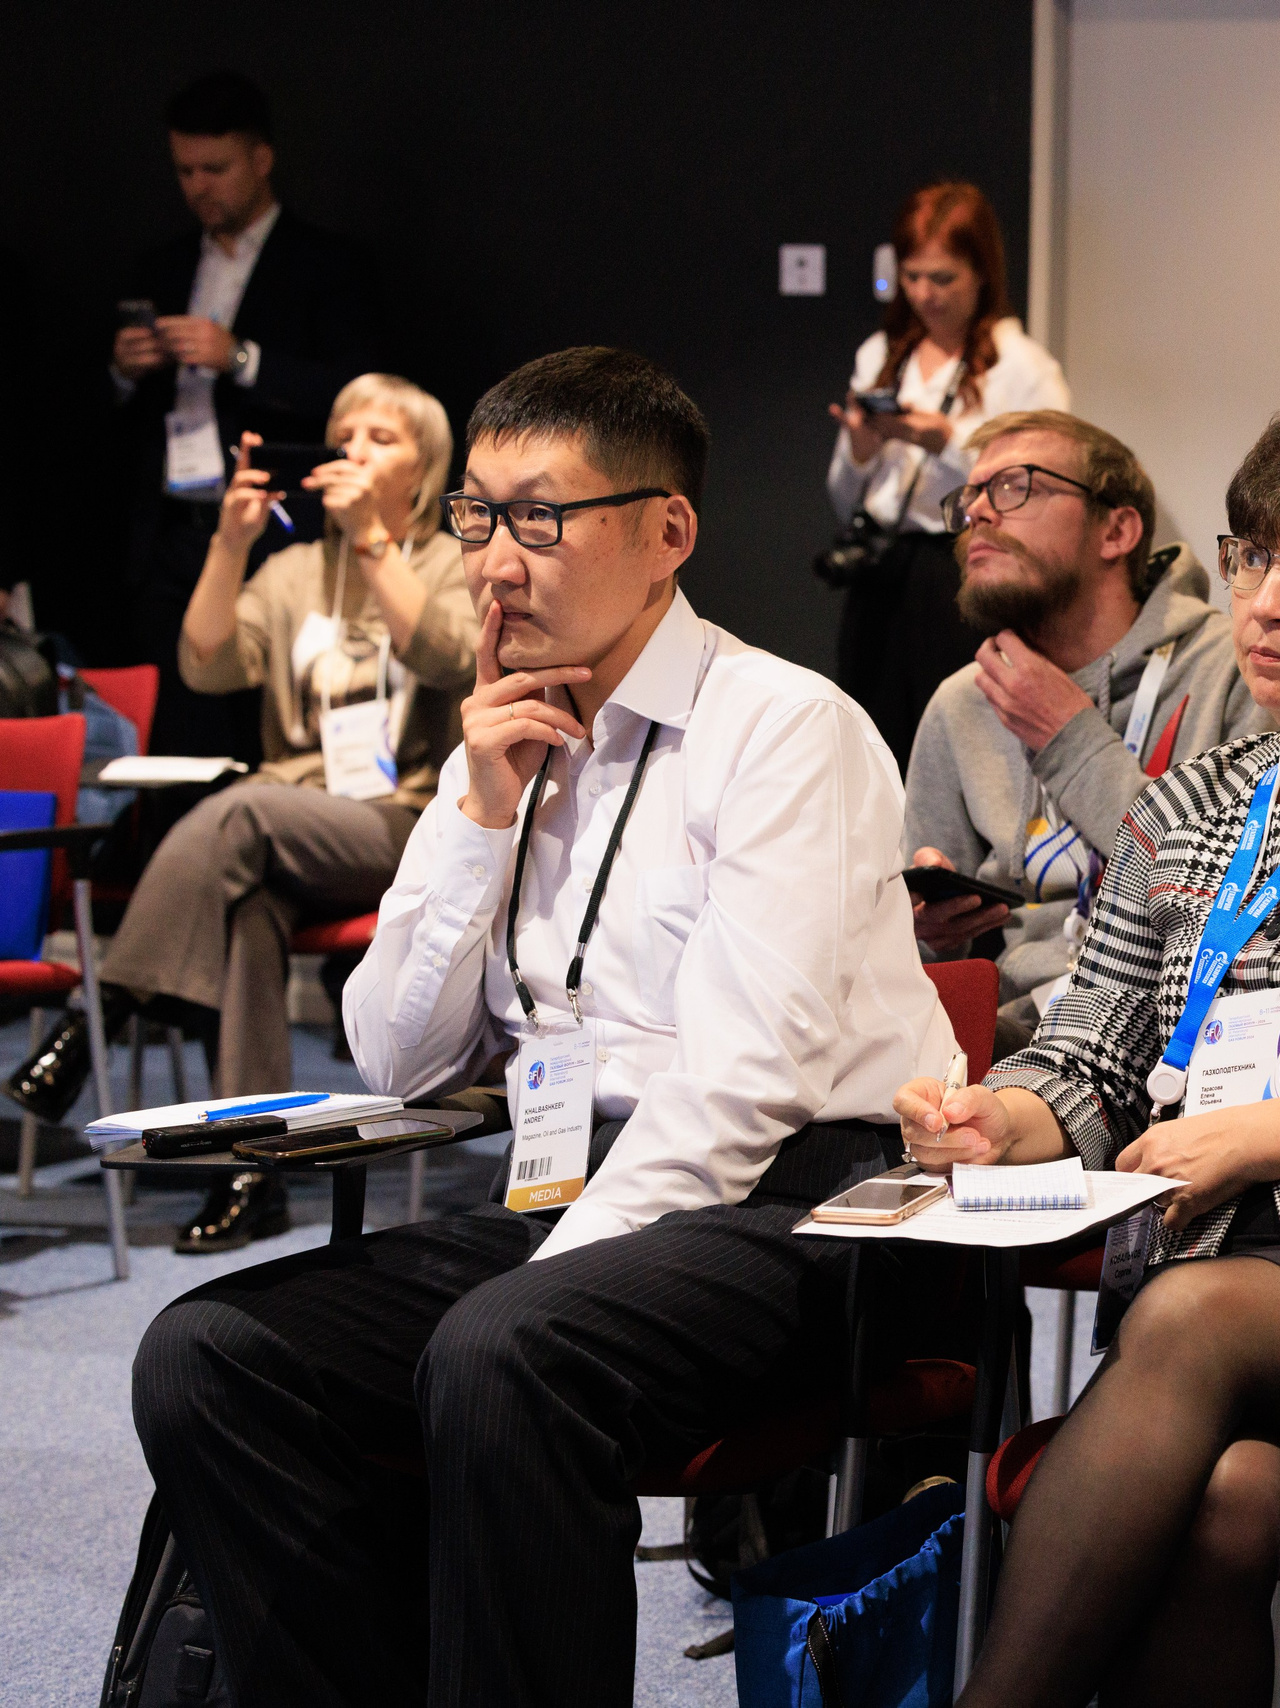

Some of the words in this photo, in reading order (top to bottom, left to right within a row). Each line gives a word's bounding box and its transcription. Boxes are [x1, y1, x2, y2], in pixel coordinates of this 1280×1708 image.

[1202, 1063, 1256, 1076] ГАЗХОЛОДТЕХНИКА
[525, 1101, 565, 1115] KHALBASHKEEV
[524, 1115, 544, 1125] ANDREY
[567, 1124, 583, 1132] Industry
[529, 1187, 562, 1203] MEDIA
